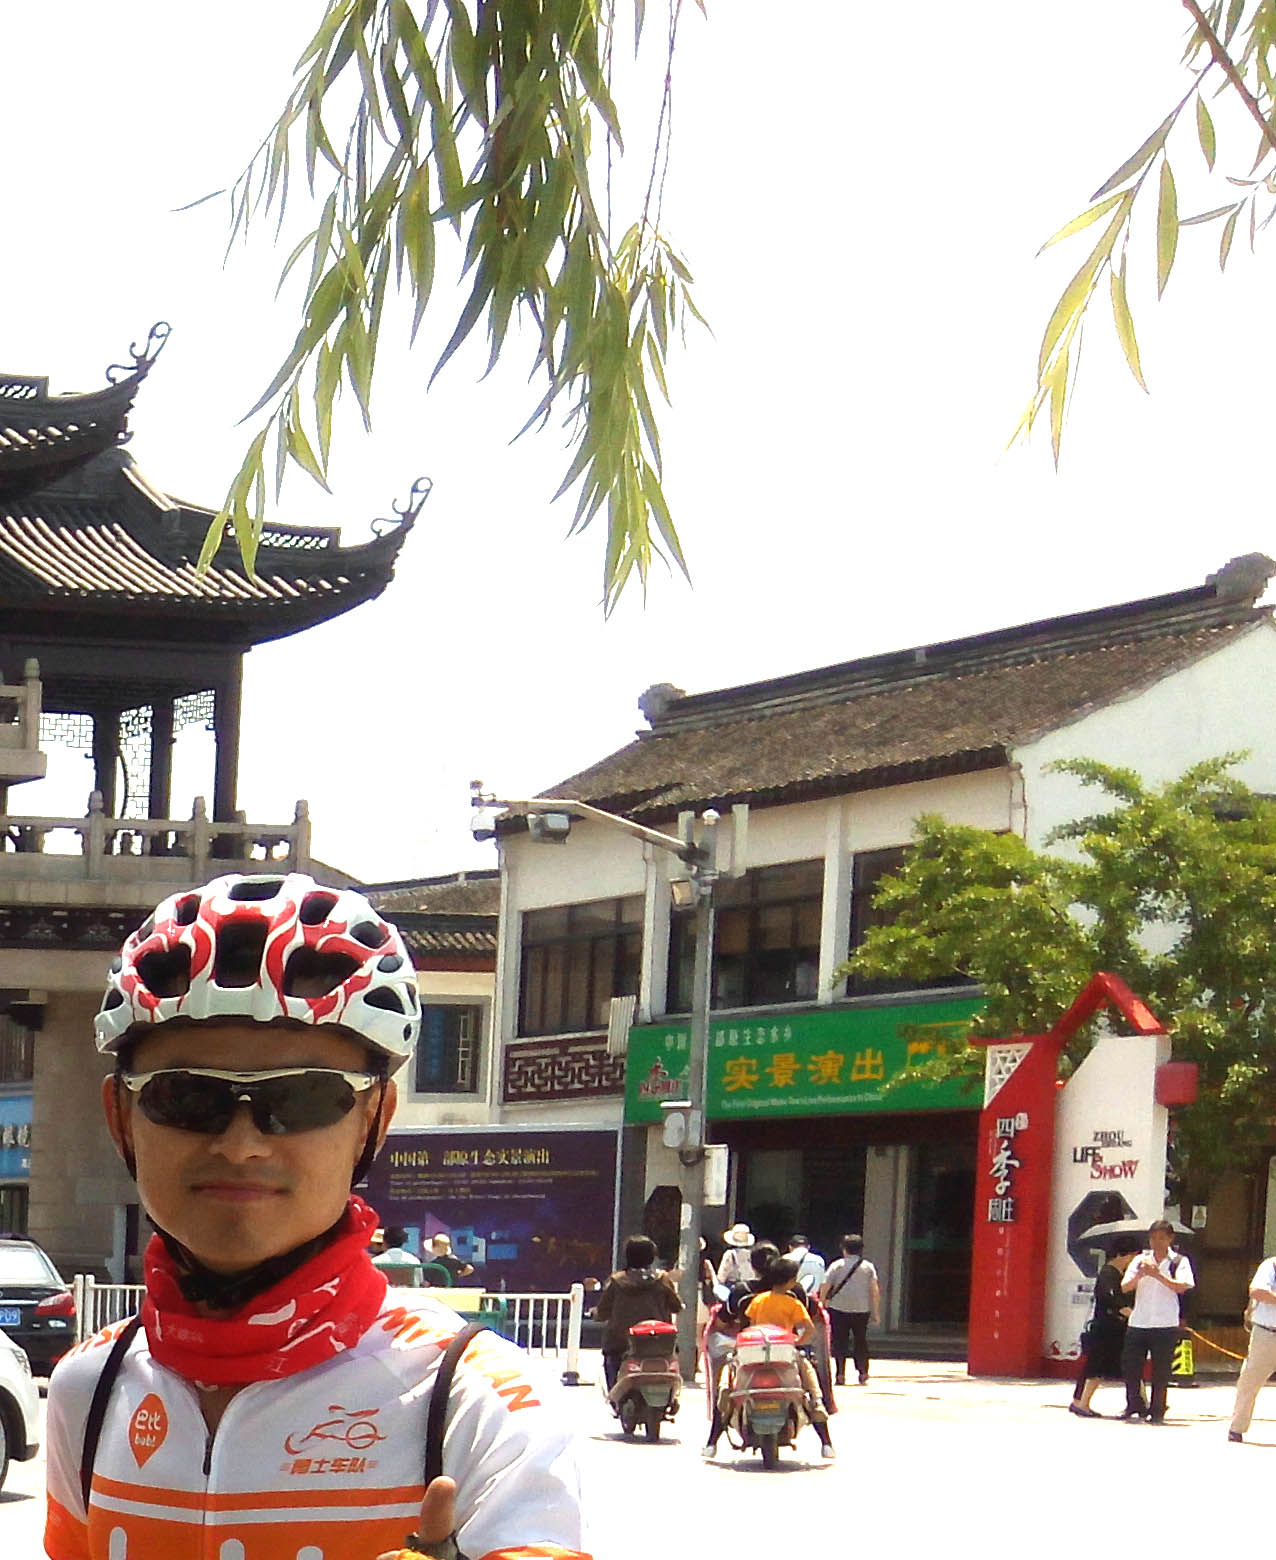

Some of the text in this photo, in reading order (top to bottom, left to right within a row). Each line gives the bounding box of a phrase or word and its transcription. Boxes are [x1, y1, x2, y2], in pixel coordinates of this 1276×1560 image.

[721, 1048, 886, 1093] 实景演出
[1090, 1160, 1140, 1180] SHOW
[135, 1410, 162, 1430] 巴比
